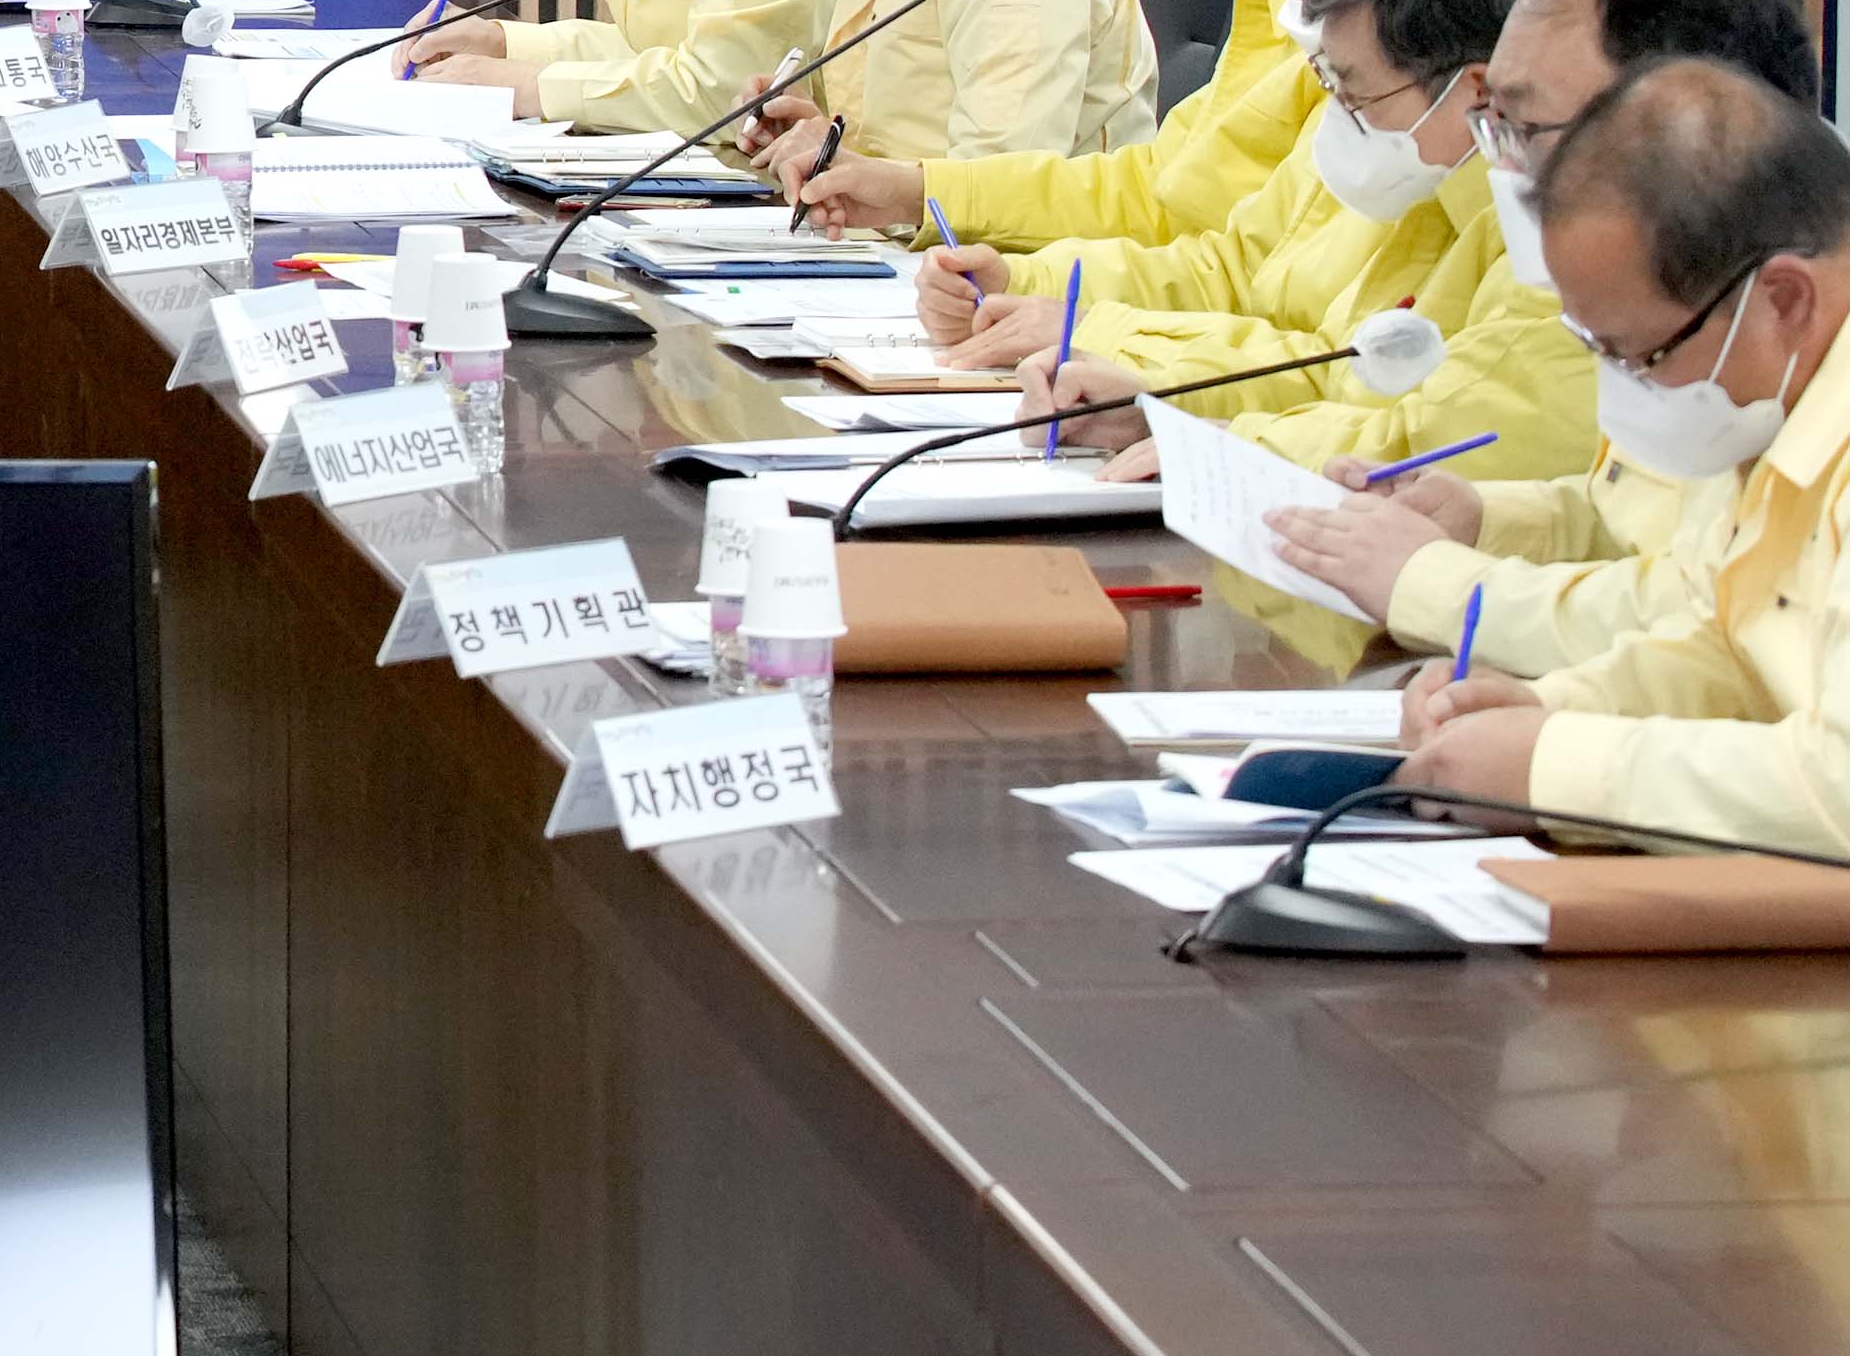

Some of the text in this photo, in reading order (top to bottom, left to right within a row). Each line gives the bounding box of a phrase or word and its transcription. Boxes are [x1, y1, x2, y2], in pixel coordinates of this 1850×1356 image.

[26, 134, 121, 179] 해양수산국
[101, 215, 236, 255] 일자리경제본부
[314, 425, 465, 484] 에너지산업국
[449, 587, 649, 653] 정책기획관
[621, 745, 819, 818] 자치행정국
